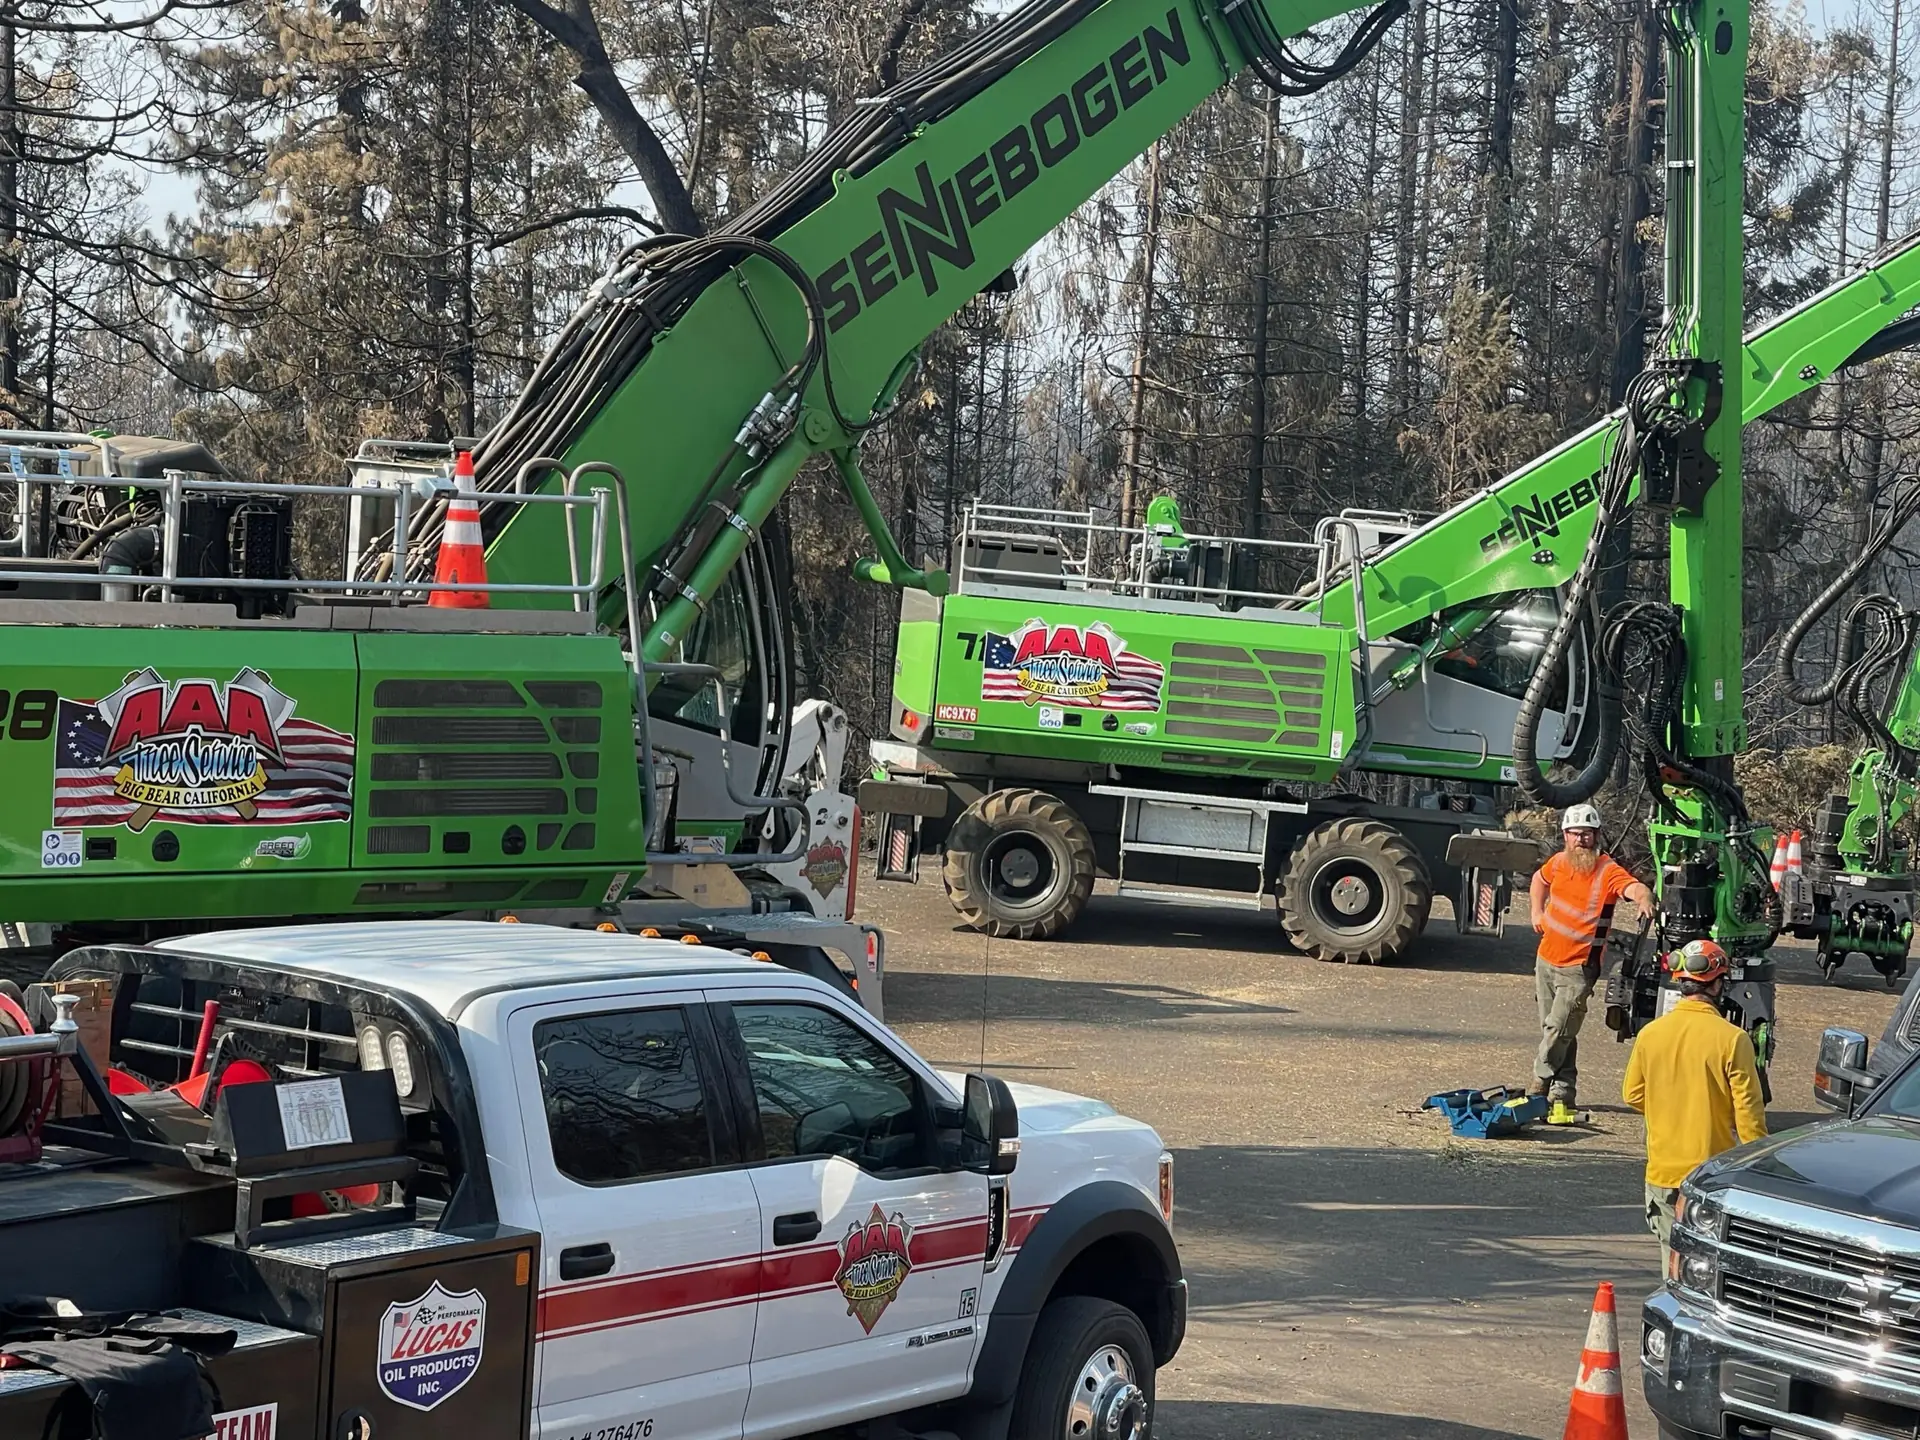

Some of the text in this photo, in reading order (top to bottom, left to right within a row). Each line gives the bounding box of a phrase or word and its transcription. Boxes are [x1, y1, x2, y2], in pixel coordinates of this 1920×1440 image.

[816, 8, 1191, 334] SENNEBOGEN
[1014, 628, 1116, 672] AAA
[1021, 655, 1102, 685] Tree Service
[1020, 678, 1104, 696] BIG BEAR CALIFORNIA
[0, 690, 58, 740] 8
[107, 683, 282, 757] AAA
[938, 705, 977, 722] HC9X76
[119, 733, 258, 788] Tree Service
[122, 780, 261, 805] BIG BEAR CALIFORNIA
[842, 1224, 909, 1271] AAA
[845, 1253, 899, 1287] Tree Service
[437, 1308, 481, 1320] PERFORMANCE
[962, 1297, 974, 1316] 15
[391, 1318, 478, 1360] LUCAS
[384, 1354, 475, 1383] OIL PRODUCTS
[417, 1380, 443, 1396] INC.
[215, 1410, 272, 1440] TEAM
[597, 1418, 654, 1440] 276476
